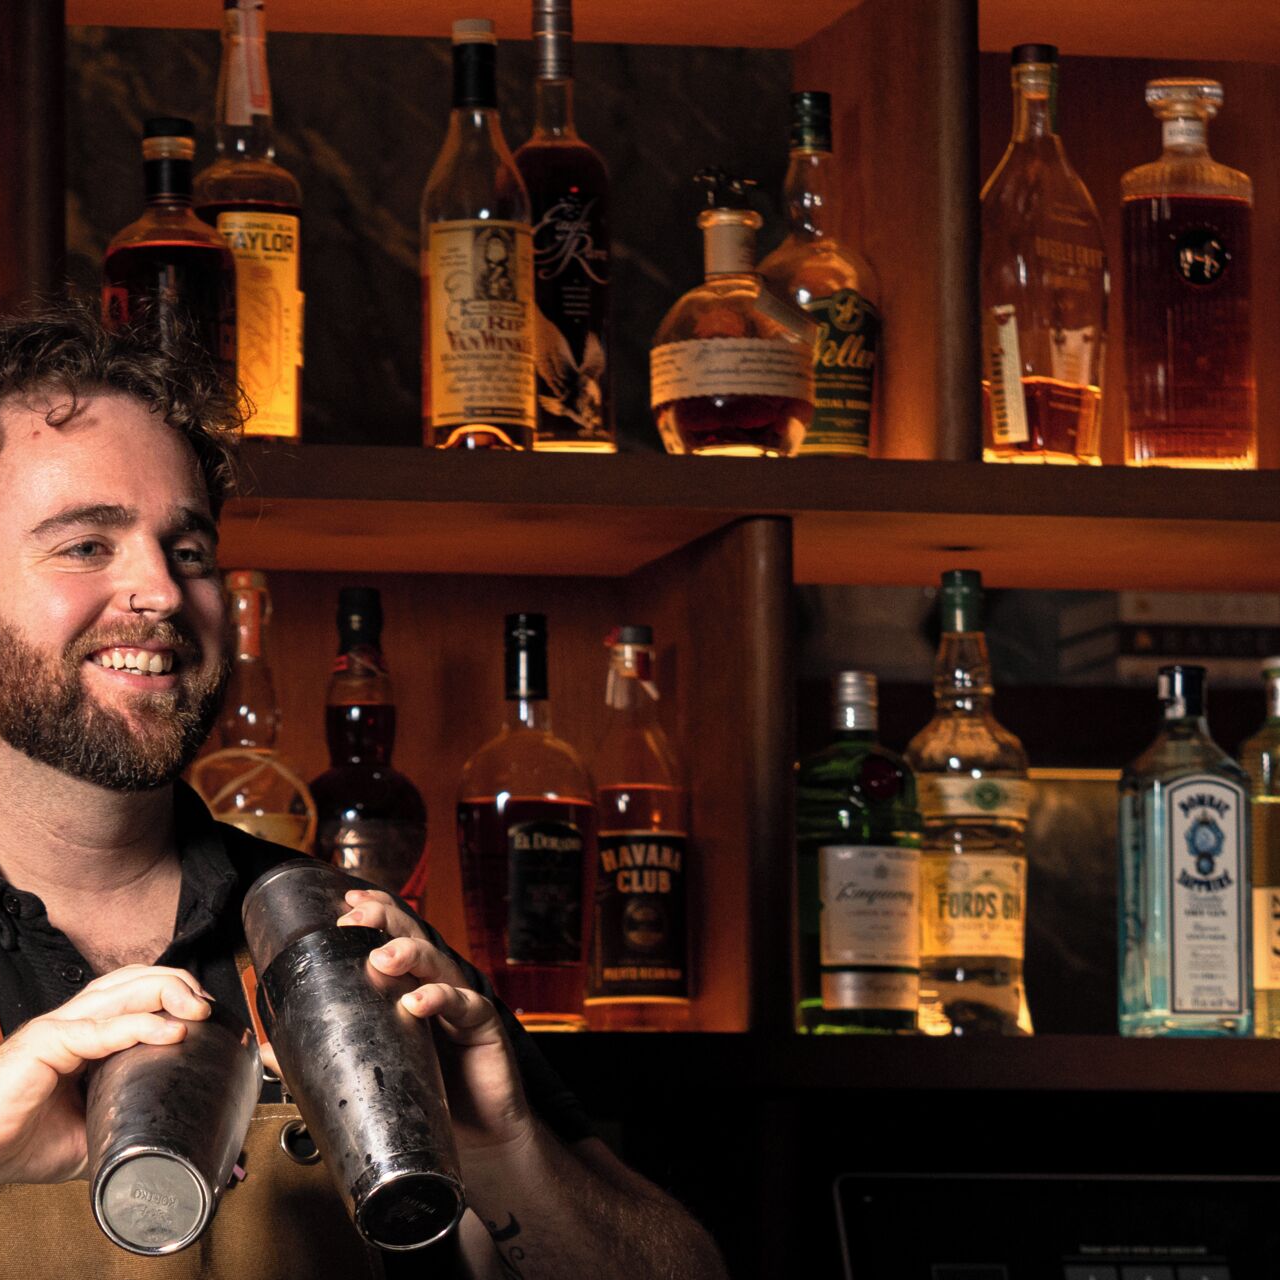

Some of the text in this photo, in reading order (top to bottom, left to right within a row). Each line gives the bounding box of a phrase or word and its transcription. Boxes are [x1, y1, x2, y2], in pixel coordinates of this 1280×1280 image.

[222, 231, 294, 252] TAYLOR
[1178, 793, 1230, 819] BOMBAY
[615, 869, 672, 895] CLUB
[1178, 867, 1235, 892] SAPPHIRE
[937, 892, 996, 919] FORDS
